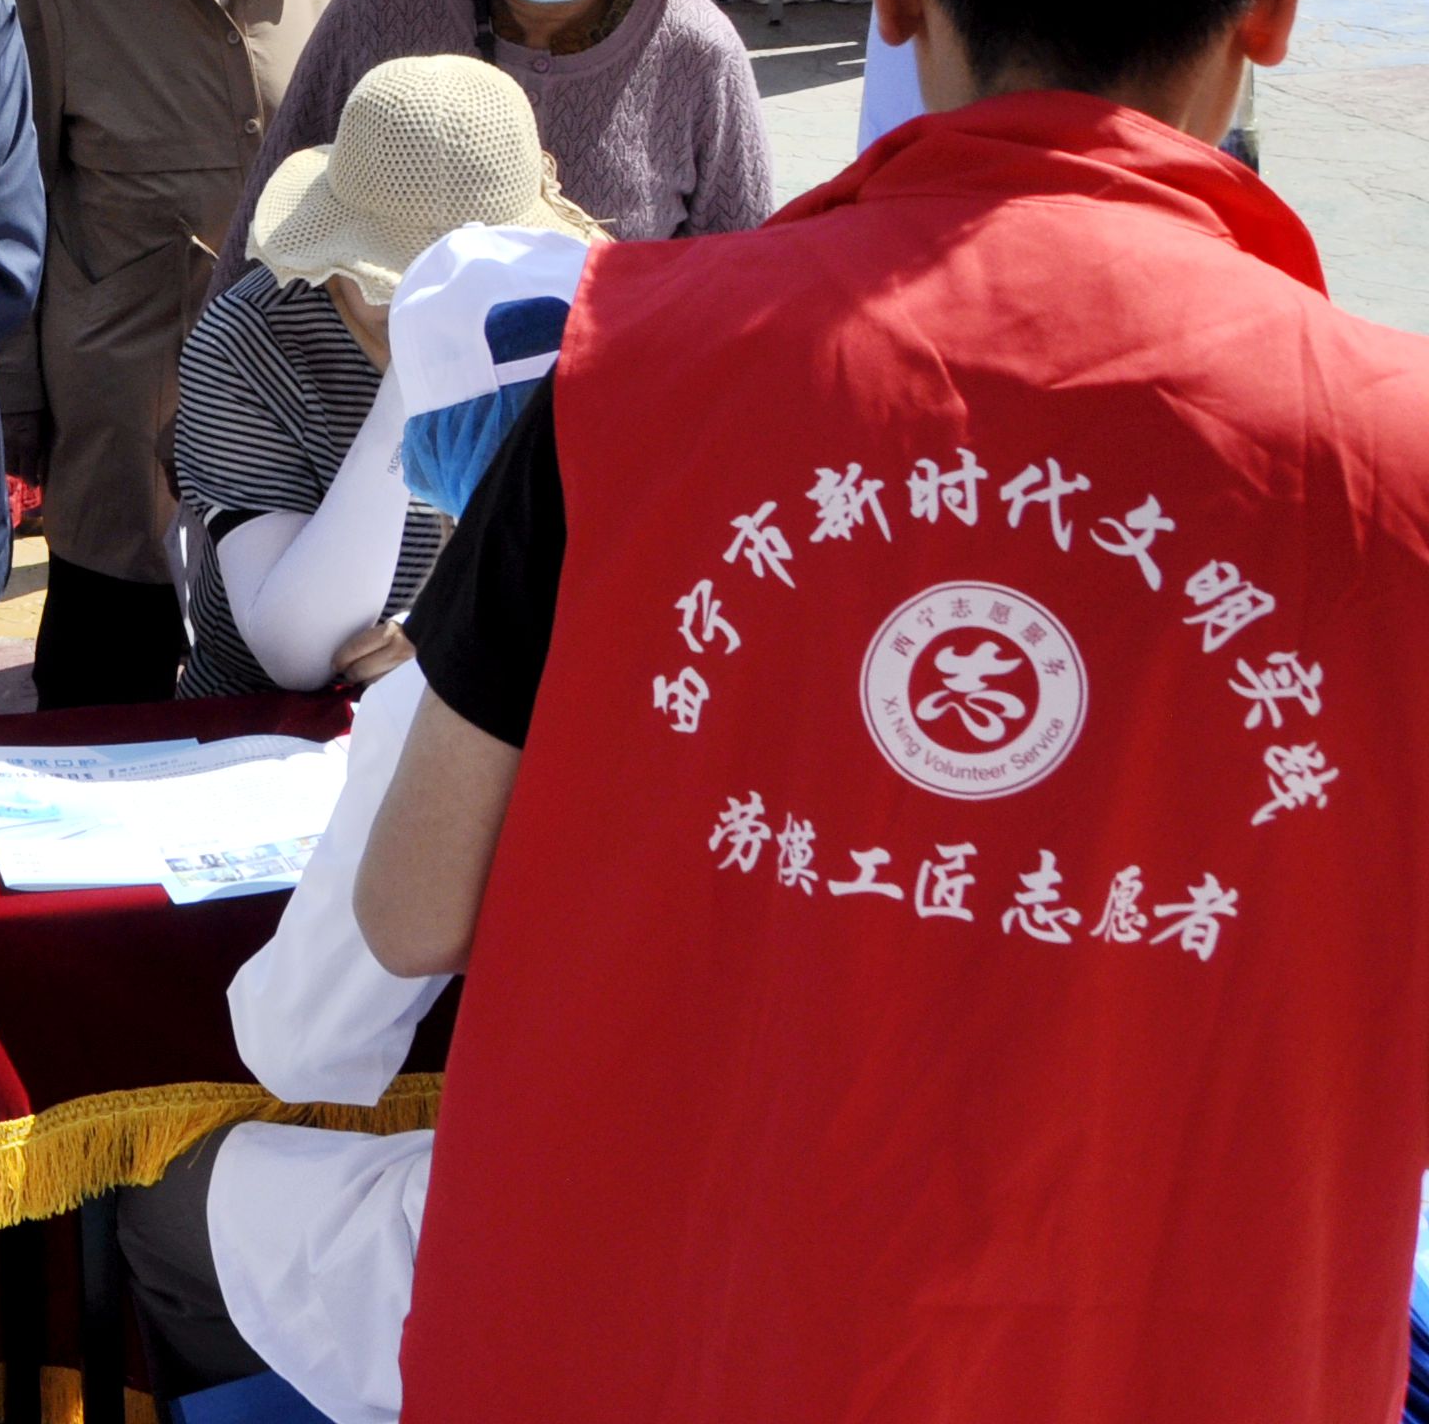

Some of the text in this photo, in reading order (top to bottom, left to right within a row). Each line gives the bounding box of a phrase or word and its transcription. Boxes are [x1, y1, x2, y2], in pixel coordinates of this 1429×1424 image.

[889, 596, 1068, 678] 西宁志愿服务
[882, 695, 1065, 782] Xi Ning Volunteer Service
[707, 790, 1239, 963] 劳模工匠志愿者
